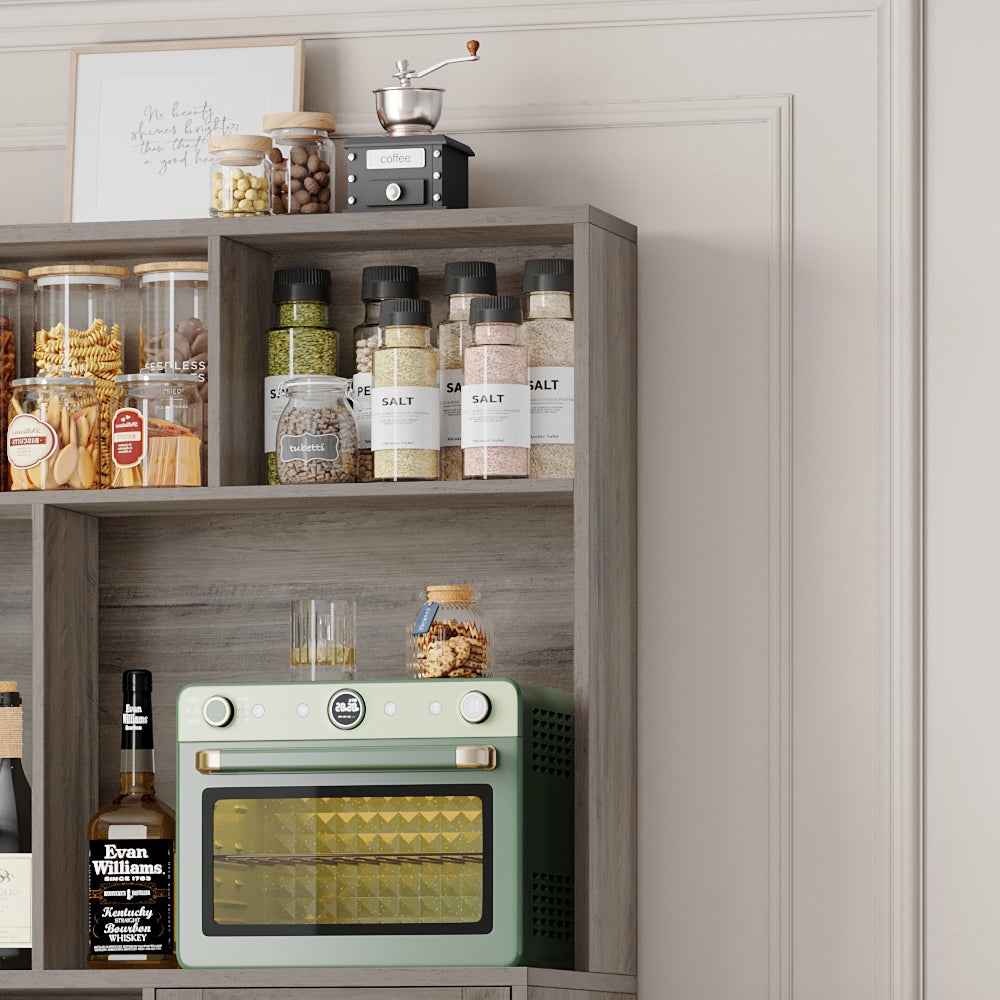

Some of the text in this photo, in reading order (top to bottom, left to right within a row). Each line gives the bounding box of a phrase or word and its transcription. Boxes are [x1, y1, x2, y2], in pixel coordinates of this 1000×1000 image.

[172, 100, 214, 124] beauty
[131, 120, 177, 141] shines
[159, 151, 188, 175] good
[380, 152, 411, 163] coffee
[381, 397, 414, 406] SALT
[472, 394, 504, 404] SALT
[289, 443, 326, 452] tubetti
[125, 704, 142, 713] Evan
[123, 713, 148, 725] Williams
[104, 844, 149, 859] Evan
[101, 906, 153, 920] Kentucky
[104, 922, 151, 934] Bourbon
[108, 934, 148, 943] WHISKEY
